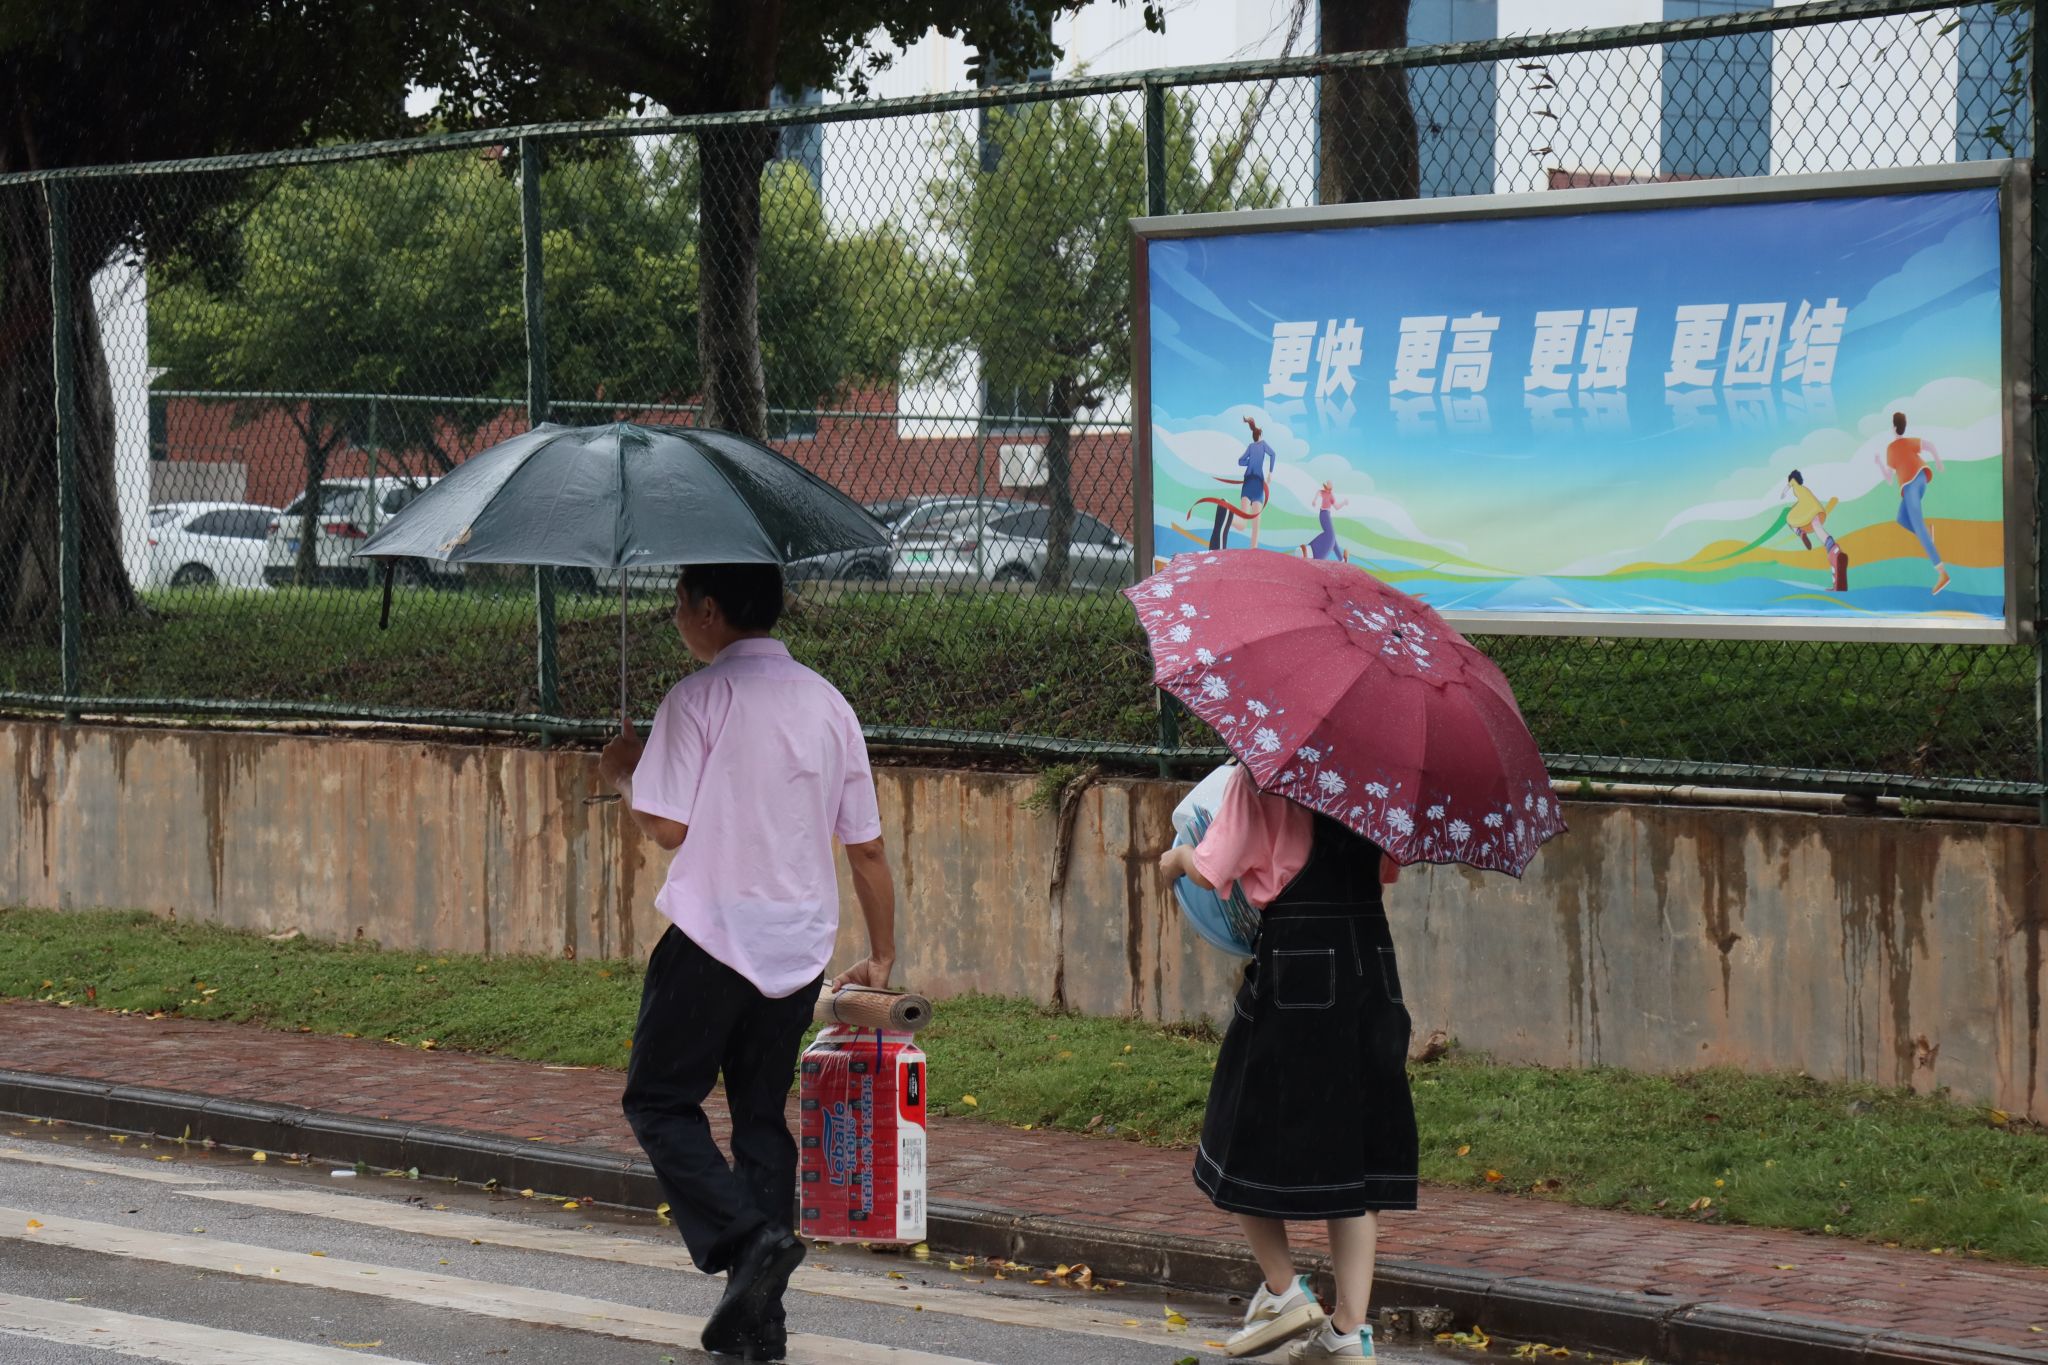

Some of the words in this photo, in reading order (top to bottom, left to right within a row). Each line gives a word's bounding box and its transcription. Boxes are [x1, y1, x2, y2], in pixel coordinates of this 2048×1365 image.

[1264, 318, 1364, 398] 更快
[1389, 312, 1500, 396] 更高
[1524, 307, 1638, 391] 更强
[1664, 298, 1848, 388] 更团结
[830, 1101, 845, 1186] Lebaile
